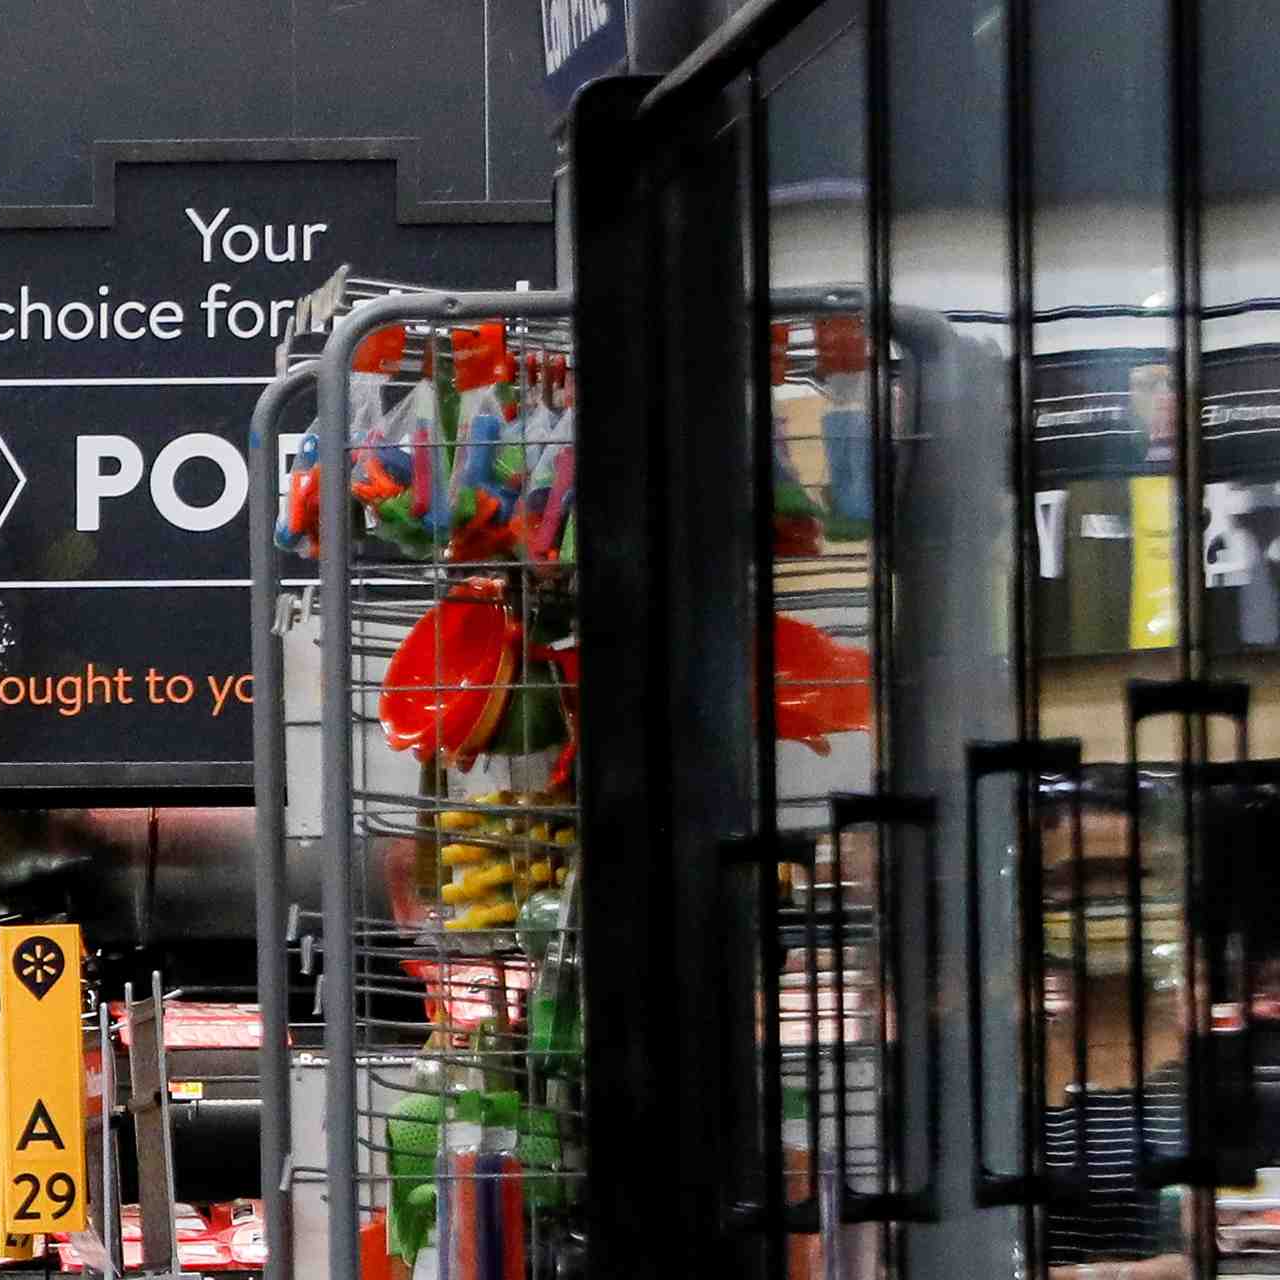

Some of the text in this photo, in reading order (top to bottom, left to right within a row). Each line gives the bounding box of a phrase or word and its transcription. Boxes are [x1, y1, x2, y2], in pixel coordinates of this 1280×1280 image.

[186, 207, 328, 263] Your
[200, 282, 294, 339] for
[76, 432, 250, 532] PO
[144, 668, 194, 704] to
[208, 675, 253, 717] yo
[16, 1099, 66, 1152] A
[13, 1172, 77, 1221] 29
